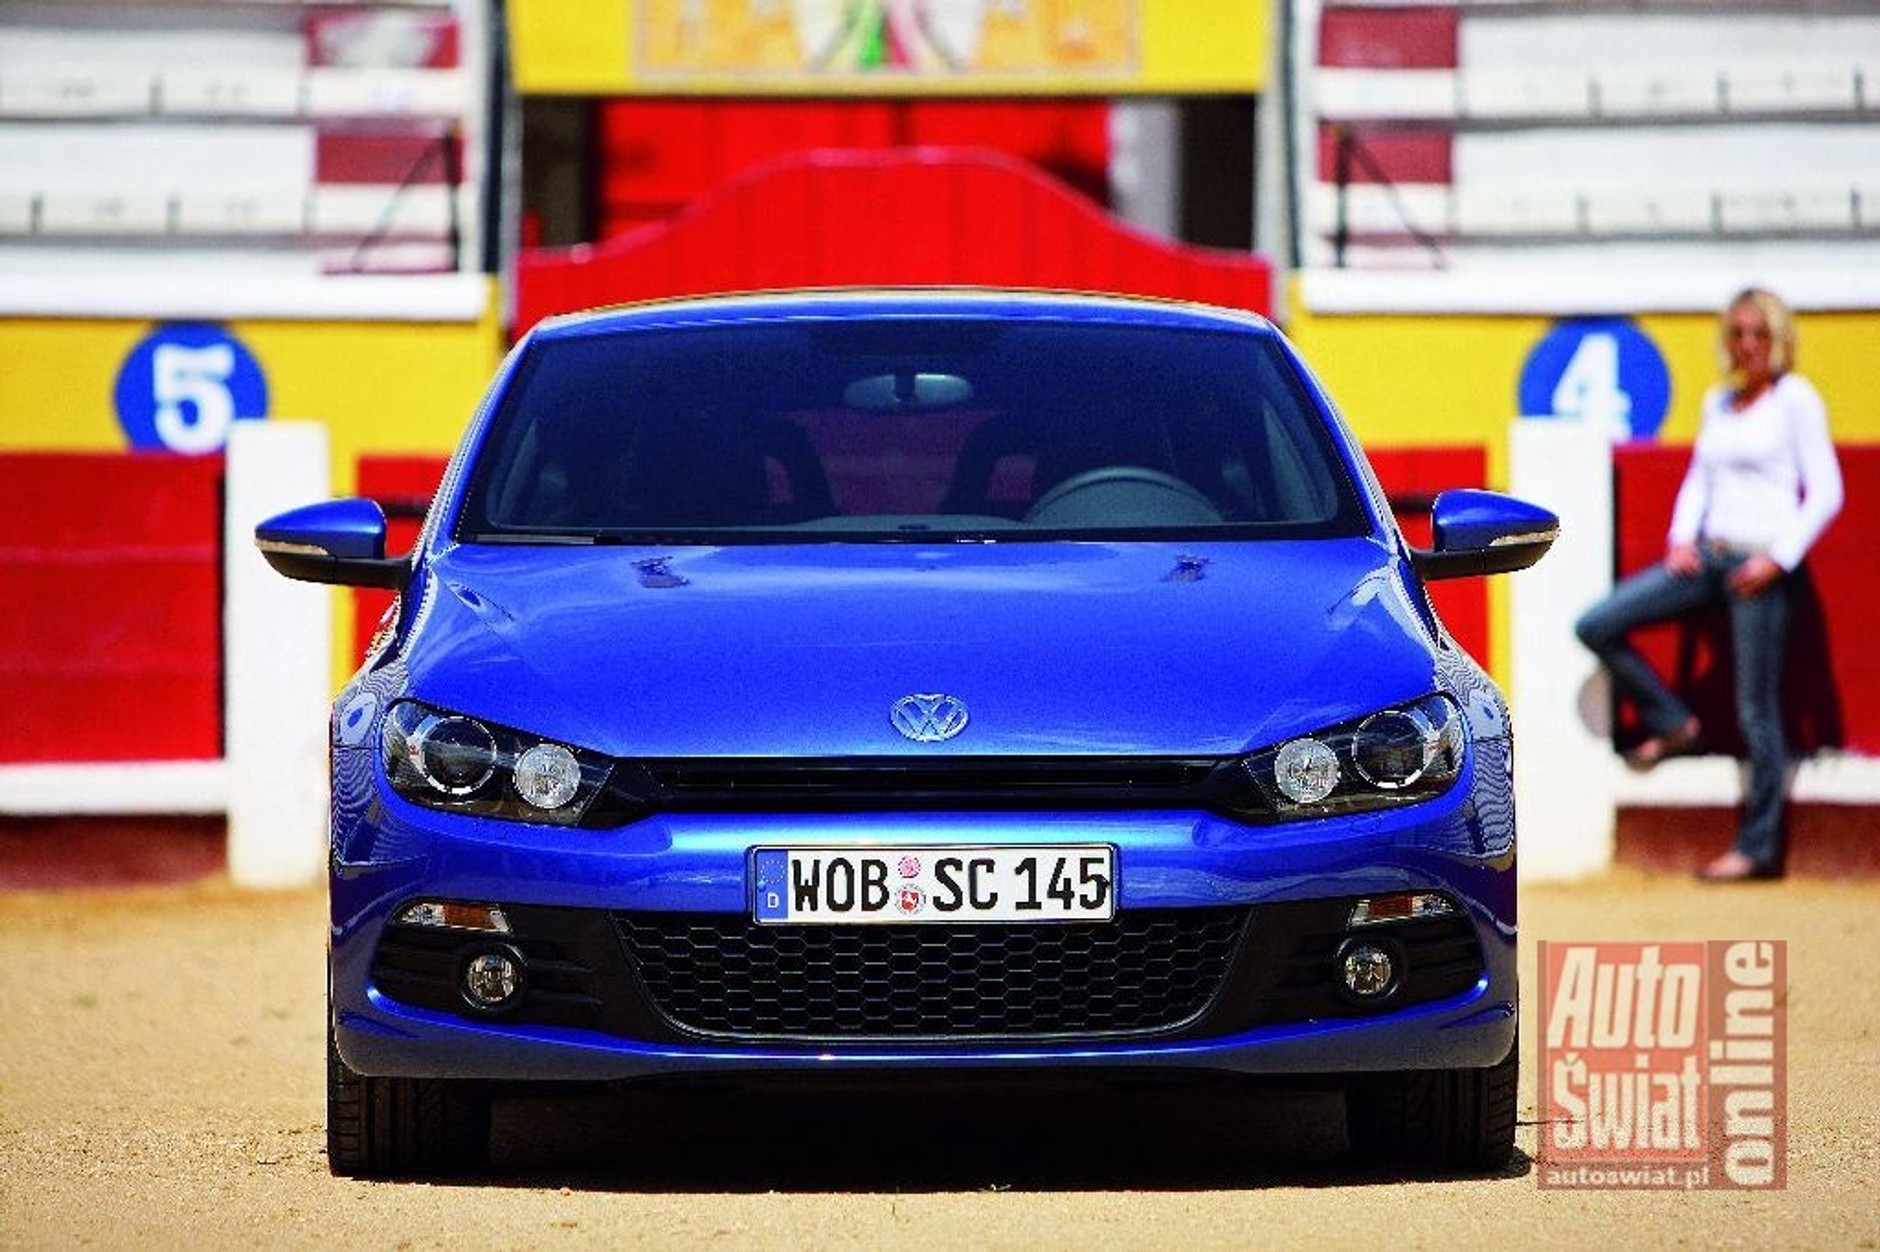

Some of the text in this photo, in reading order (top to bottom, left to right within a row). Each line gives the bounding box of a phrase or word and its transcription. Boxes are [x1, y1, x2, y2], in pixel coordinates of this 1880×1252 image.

[153, 342, 235, 455] 5
[1553, 332, 1633, 443] 4
[767, 893, 779, 908] D
[791, 857, 1110, 911] WOB SC 145
